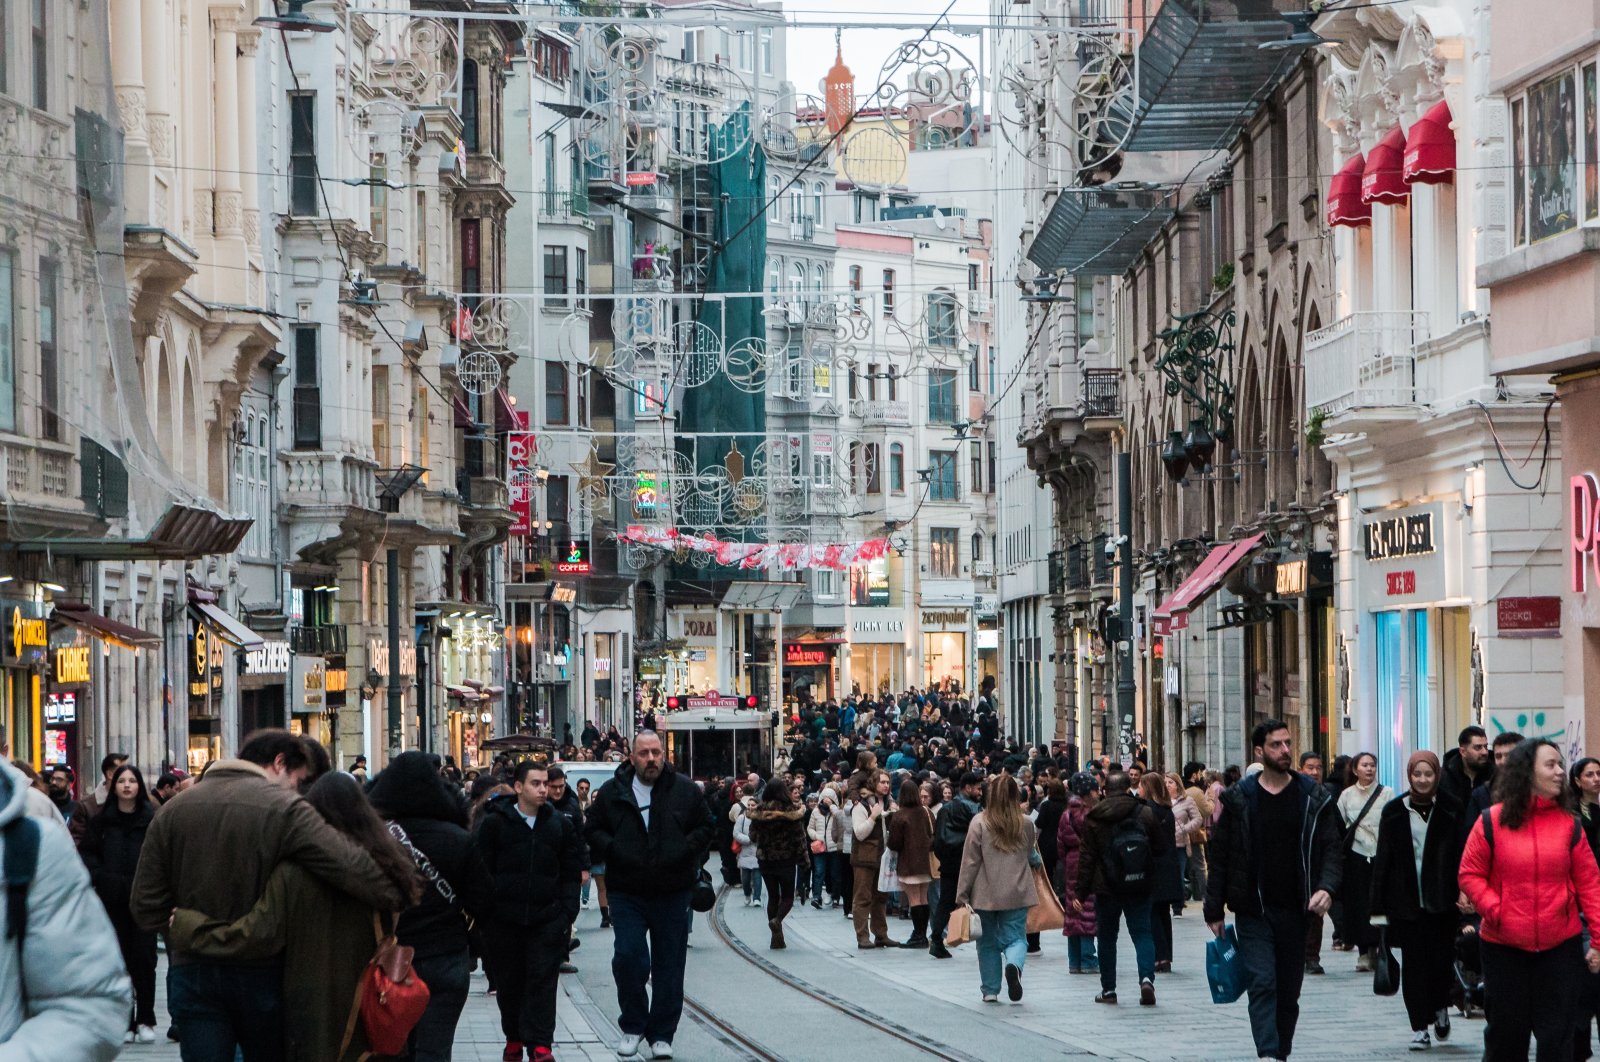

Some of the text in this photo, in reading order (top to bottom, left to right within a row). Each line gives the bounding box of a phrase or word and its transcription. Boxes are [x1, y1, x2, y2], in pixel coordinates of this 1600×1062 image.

[559, 563, 589, 572] COFFEE
[853, 621, 904, 632] JIMMY KEY
[57, 647, 90, 683] CHANGE
